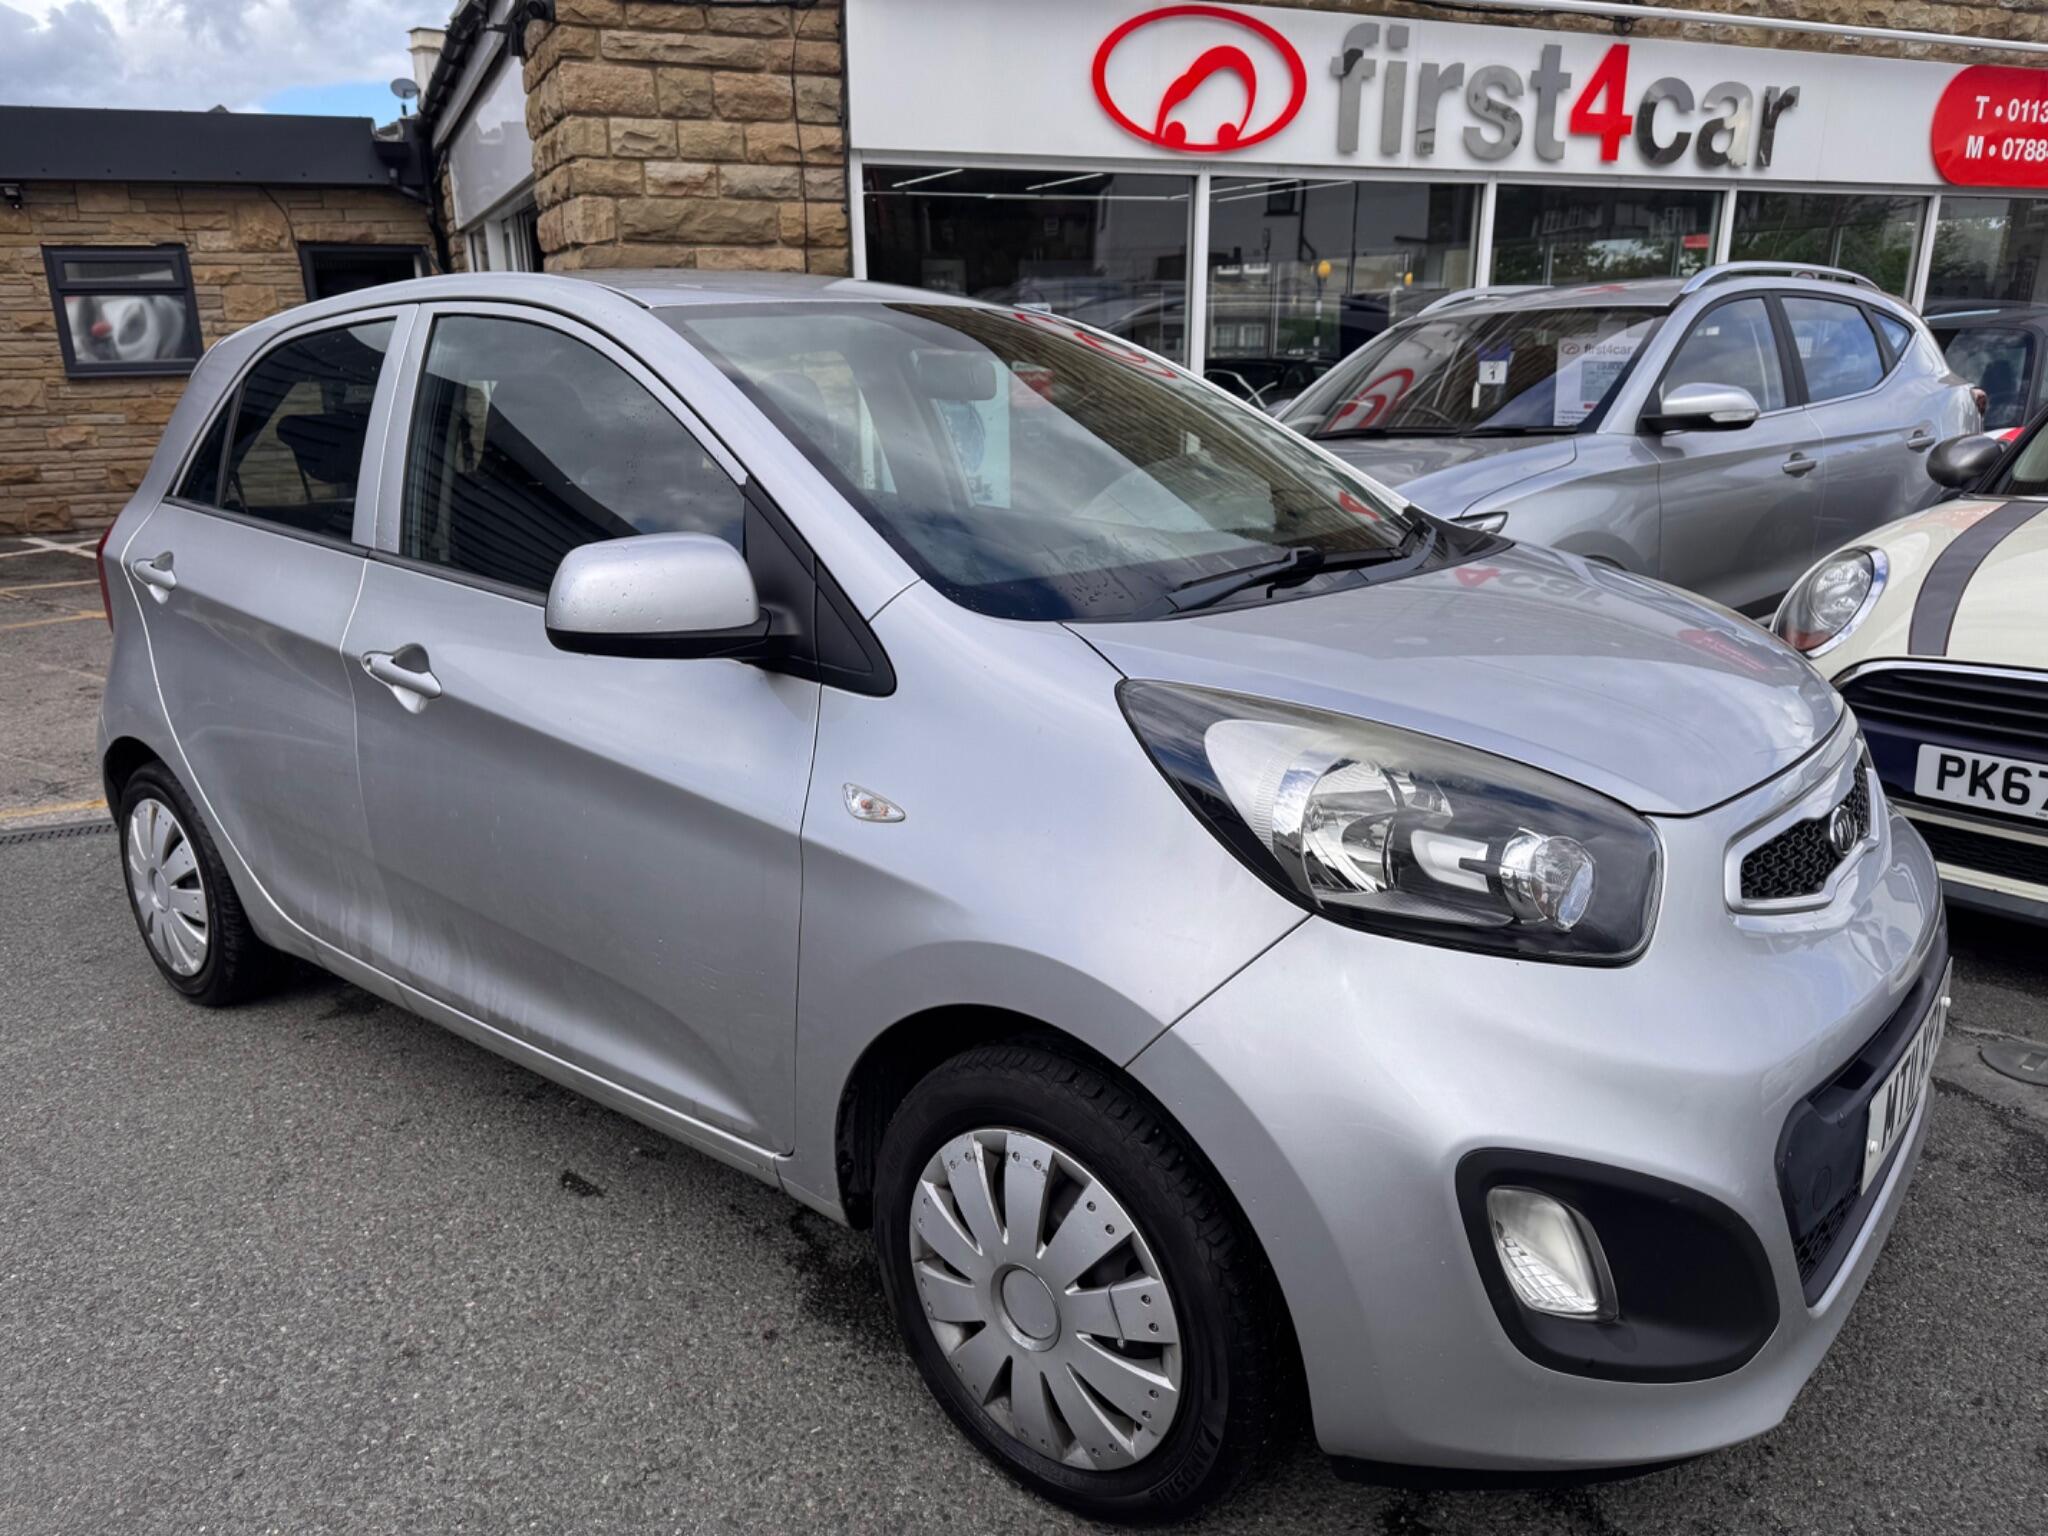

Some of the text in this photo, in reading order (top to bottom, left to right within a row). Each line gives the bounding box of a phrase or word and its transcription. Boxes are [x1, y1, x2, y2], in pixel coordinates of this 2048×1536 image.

[1330, 22, 1800, 168] first4car
[1976, 95, 2048, 124] T 0113
[1965, 135, 2048, 162] M 0788
